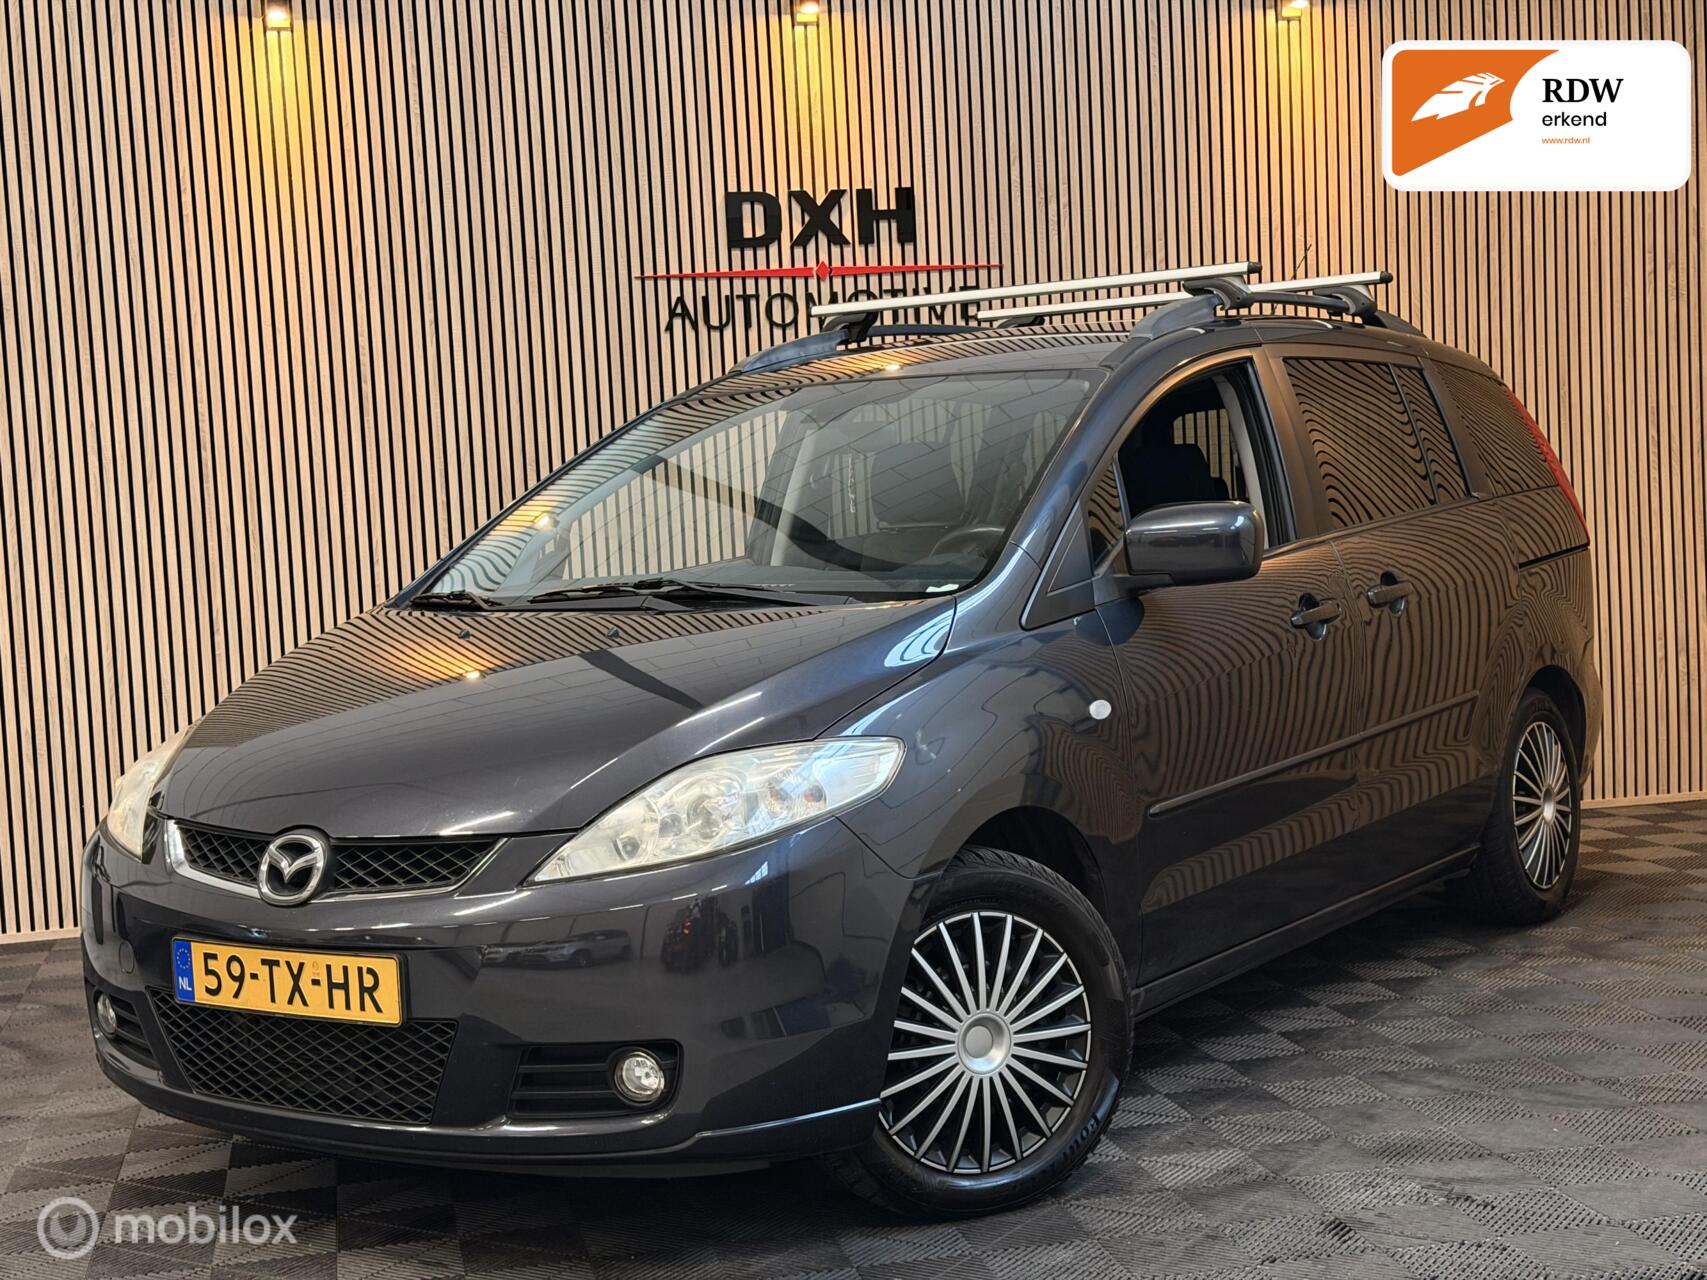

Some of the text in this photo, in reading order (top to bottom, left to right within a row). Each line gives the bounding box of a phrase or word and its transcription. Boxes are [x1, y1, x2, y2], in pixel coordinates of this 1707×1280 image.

[724, 186, 916, 249] DXH
[178, 951, 384, 1014] NL 59-TX-HR
